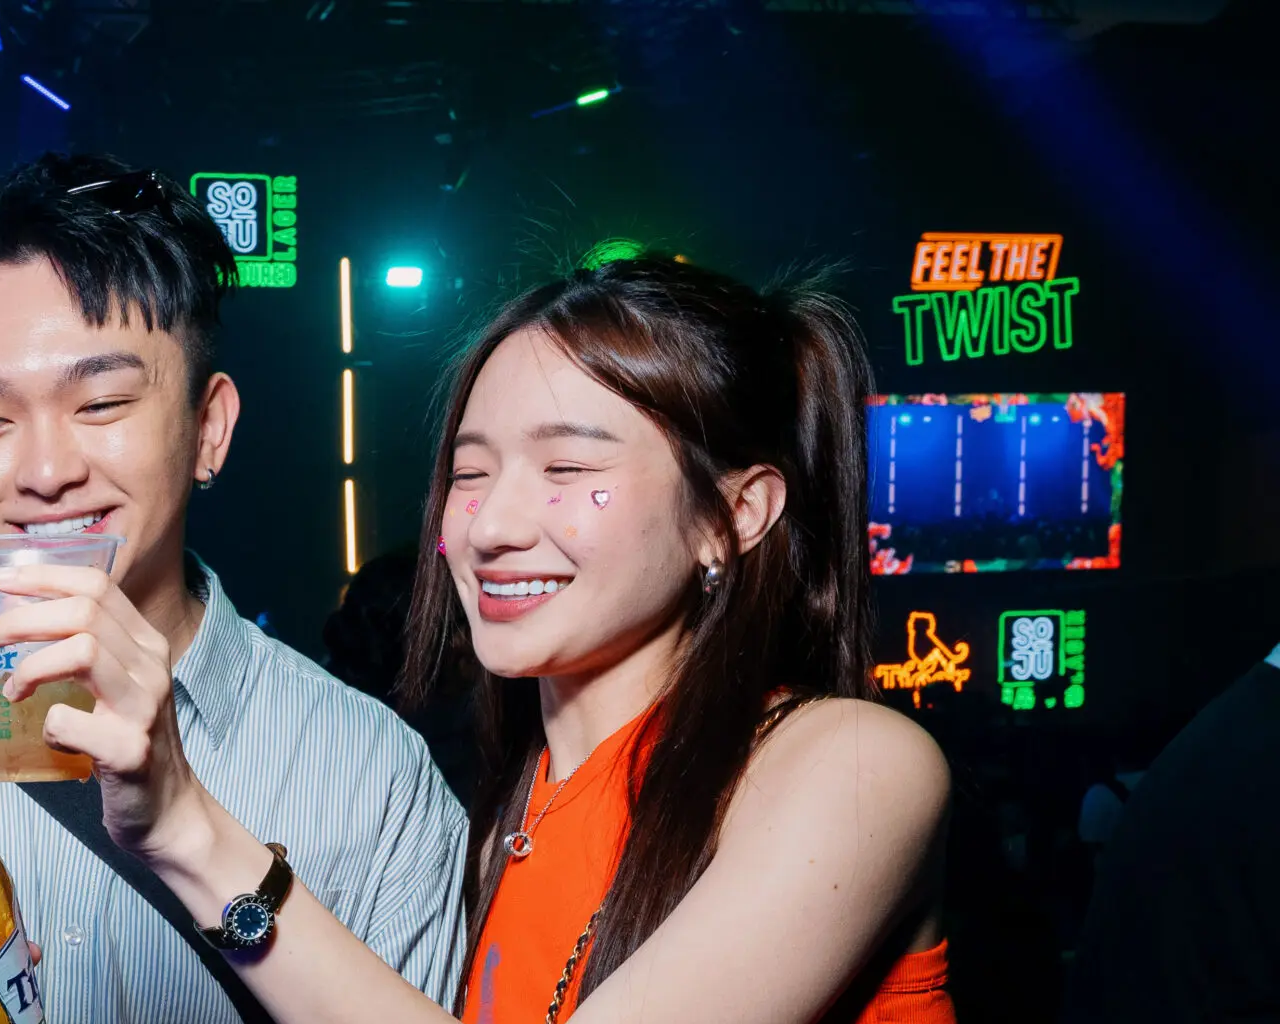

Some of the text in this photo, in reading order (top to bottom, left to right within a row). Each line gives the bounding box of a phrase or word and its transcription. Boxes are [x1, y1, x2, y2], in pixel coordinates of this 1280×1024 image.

[912, 241, 1049, 282] FEEL THE
[892, 276, 1080, 366] TWIST
[1012, 617, 1054, 651] SO
[1011, 650, 1054, 680] JU
